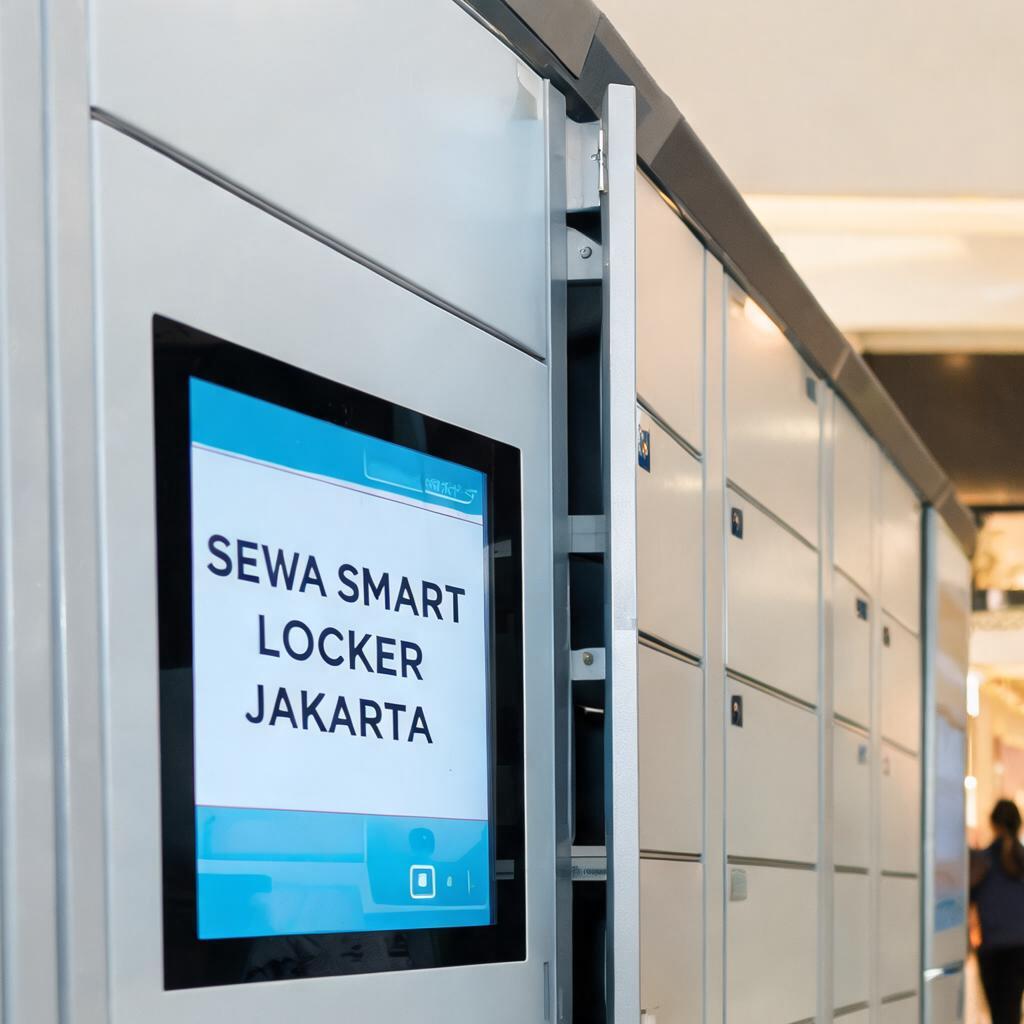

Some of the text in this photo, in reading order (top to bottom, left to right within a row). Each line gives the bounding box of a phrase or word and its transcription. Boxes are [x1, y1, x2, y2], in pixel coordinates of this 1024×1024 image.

[207, 534, 466, 624] SEWA SMART
[258, 614, 424, 681] LOCKER
[245, 684, 434, 744] JAKARTA
